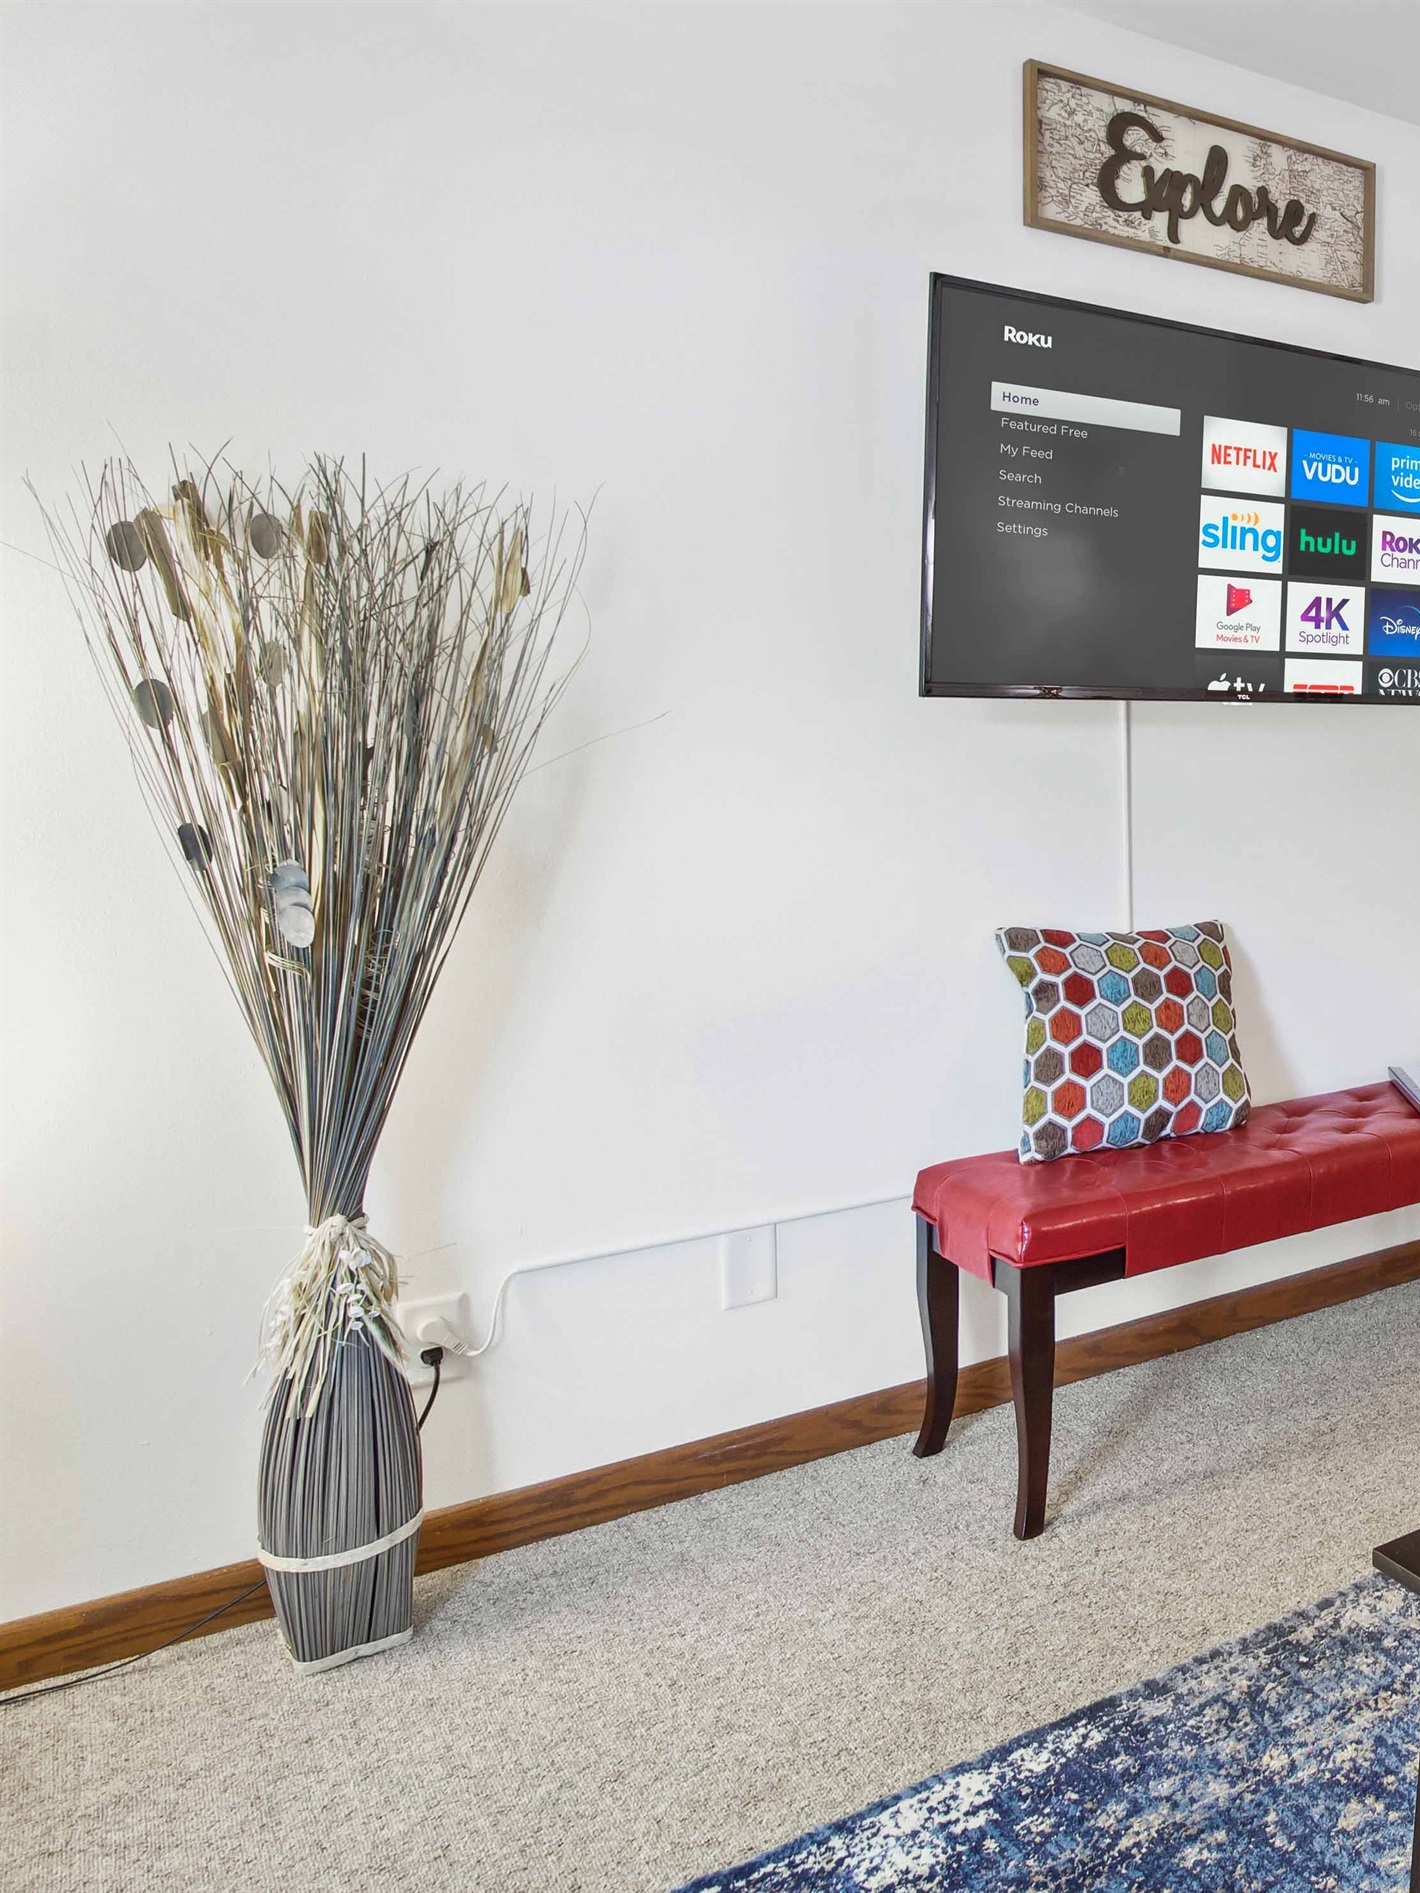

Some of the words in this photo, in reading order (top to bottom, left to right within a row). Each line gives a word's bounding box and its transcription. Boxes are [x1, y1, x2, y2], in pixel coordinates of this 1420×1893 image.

[1098, 111, 1317, 246] Explore
[1003, 325, 1053, 349] Roku
[1002, 391, 1040, 406] Home
[1356, 392, 1375, 404] 11:56
[1377, 397, 1391, 406] am
[1001, 417, 1057, 435] Featured
[1061, 426, 1089, 439] Free
[1409, 428, 1417, 437] 16
[999, 443, 1019, 457] My
[1022, 446, 1053, 460] Feed
[1210, 443, 1279, 473] NETFLIX
[1309, 452, 1337, 463] MOVIES
[1344, 456, 1354, 464] TV
[999, 469, 1042, 484] Search
[1302, 459, 1360, 486] VUDU
[998, 495, 1061, 514] Streaming
[1064, 502, 1119, 518] Channels
[996, 521, 1049, 538] Settings
[1201, 512, 1282, 563] sling
[1299, 528, 1357, 556] hulu
[1300, 596, 1350, 632] 4K
[1216, 621, 1245, 633] Google
[1245, 623, 1261, 634] Play
[1216, 633, 1242, 643] Movies
[1243, 635, 1249, 643] &
[1250, 635, 1261, 644] TV
[1298, 630, 1350, 646] Spotlight
